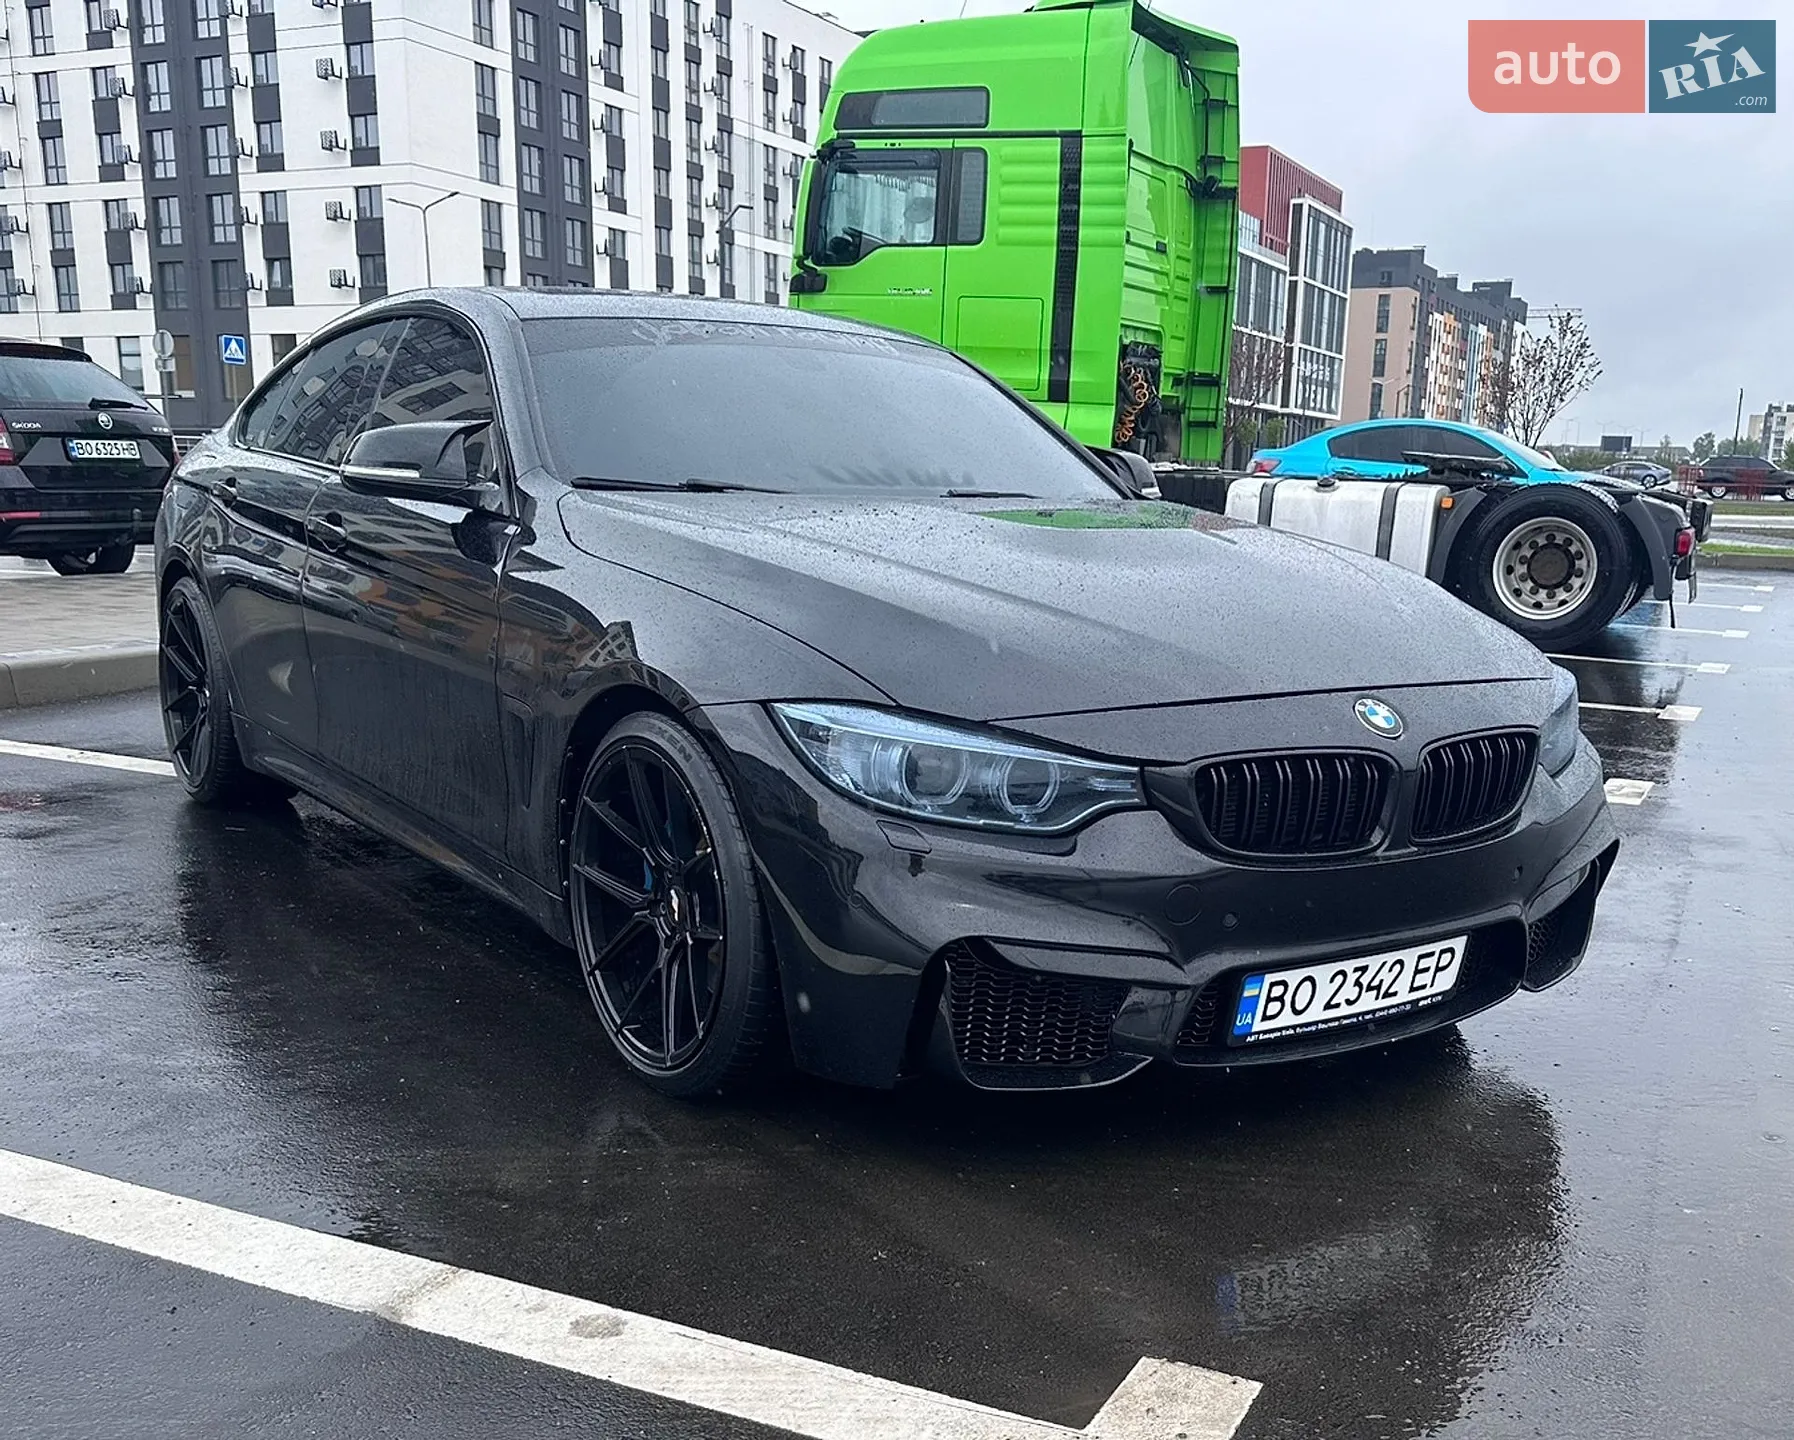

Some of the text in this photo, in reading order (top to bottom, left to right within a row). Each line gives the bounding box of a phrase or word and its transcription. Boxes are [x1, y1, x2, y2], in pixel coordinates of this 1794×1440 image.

[75, 442, 93, 456] BO
[95, 442, 121, 456] 6325
[1260, 946, 1456, 1022] BO 2342 EP
[1236, 1011, 1252, 1026] UA
